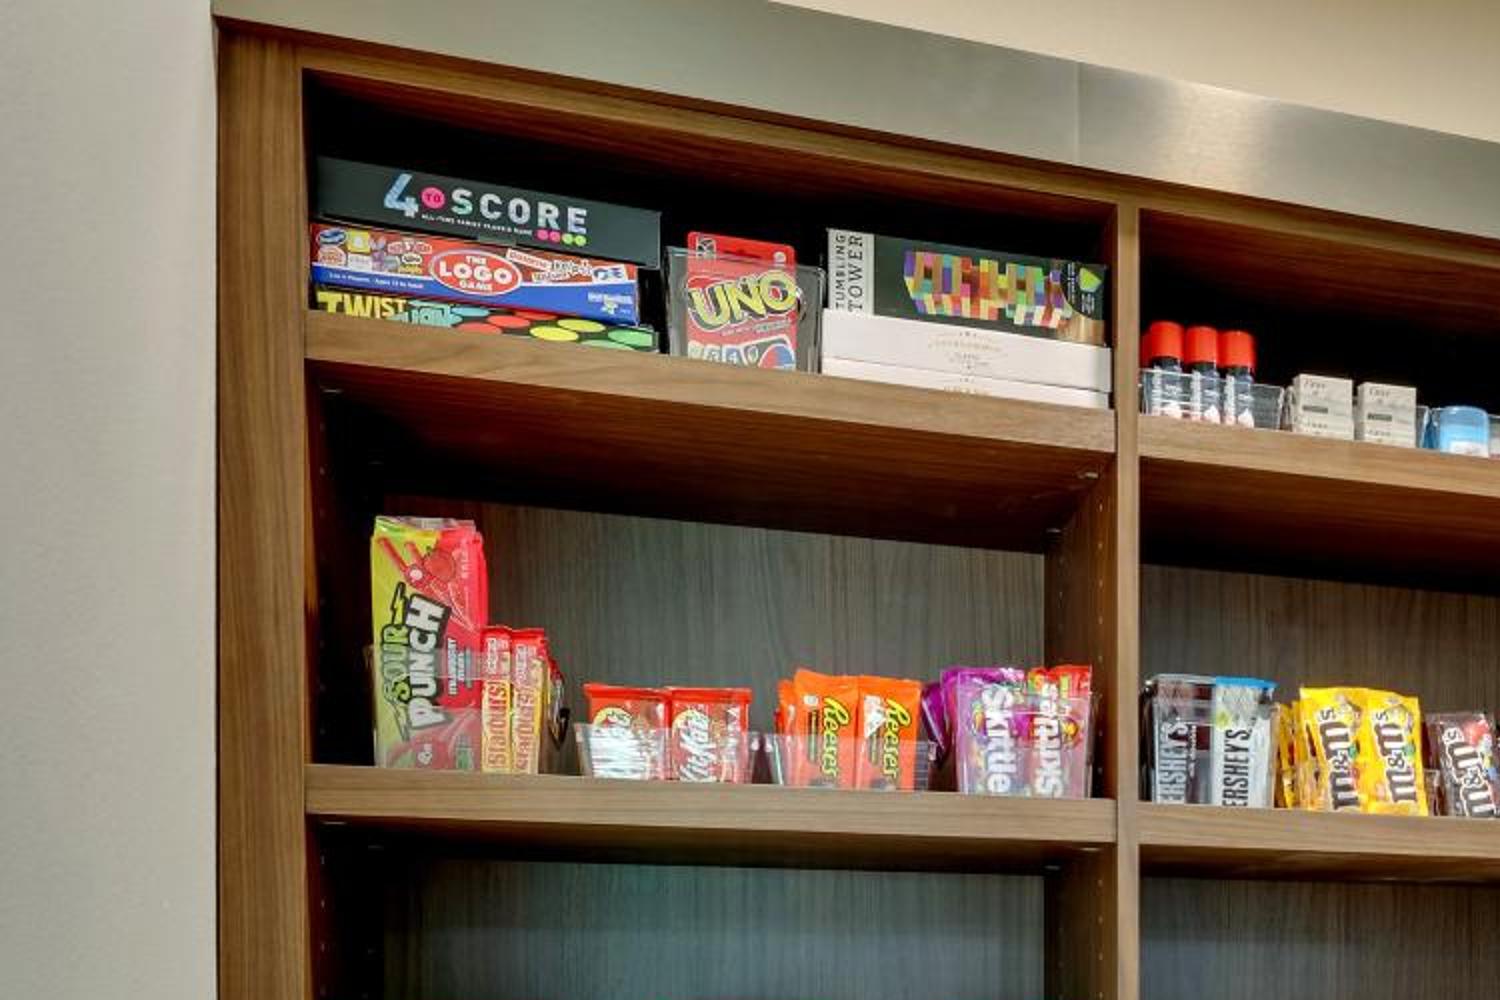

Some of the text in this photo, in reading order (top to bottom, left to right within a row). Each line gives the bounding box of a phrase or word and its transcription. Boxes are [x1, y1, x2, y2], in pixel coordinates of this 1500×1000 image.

[383, 172, 419, 219] 4
[451, 188, 588, 235] SCORE
[316, 291, 407, 319] TWIST
[439, 261, 513, 286] LOGO
[688, 270, 797, 326] UNO
[835, 234, 846, 310] TUMBLING
[848, 235, 863, 313] TOWER
[381, 623, 410, 701] SOUR
[407, 596, 448, 728] PUNCH
[982, 684, 1018, 793] Skittle
[1159, 720, 1189, 804] ERSHEY'S
[1222, 728, 1251, 807] ERSHEY'S
